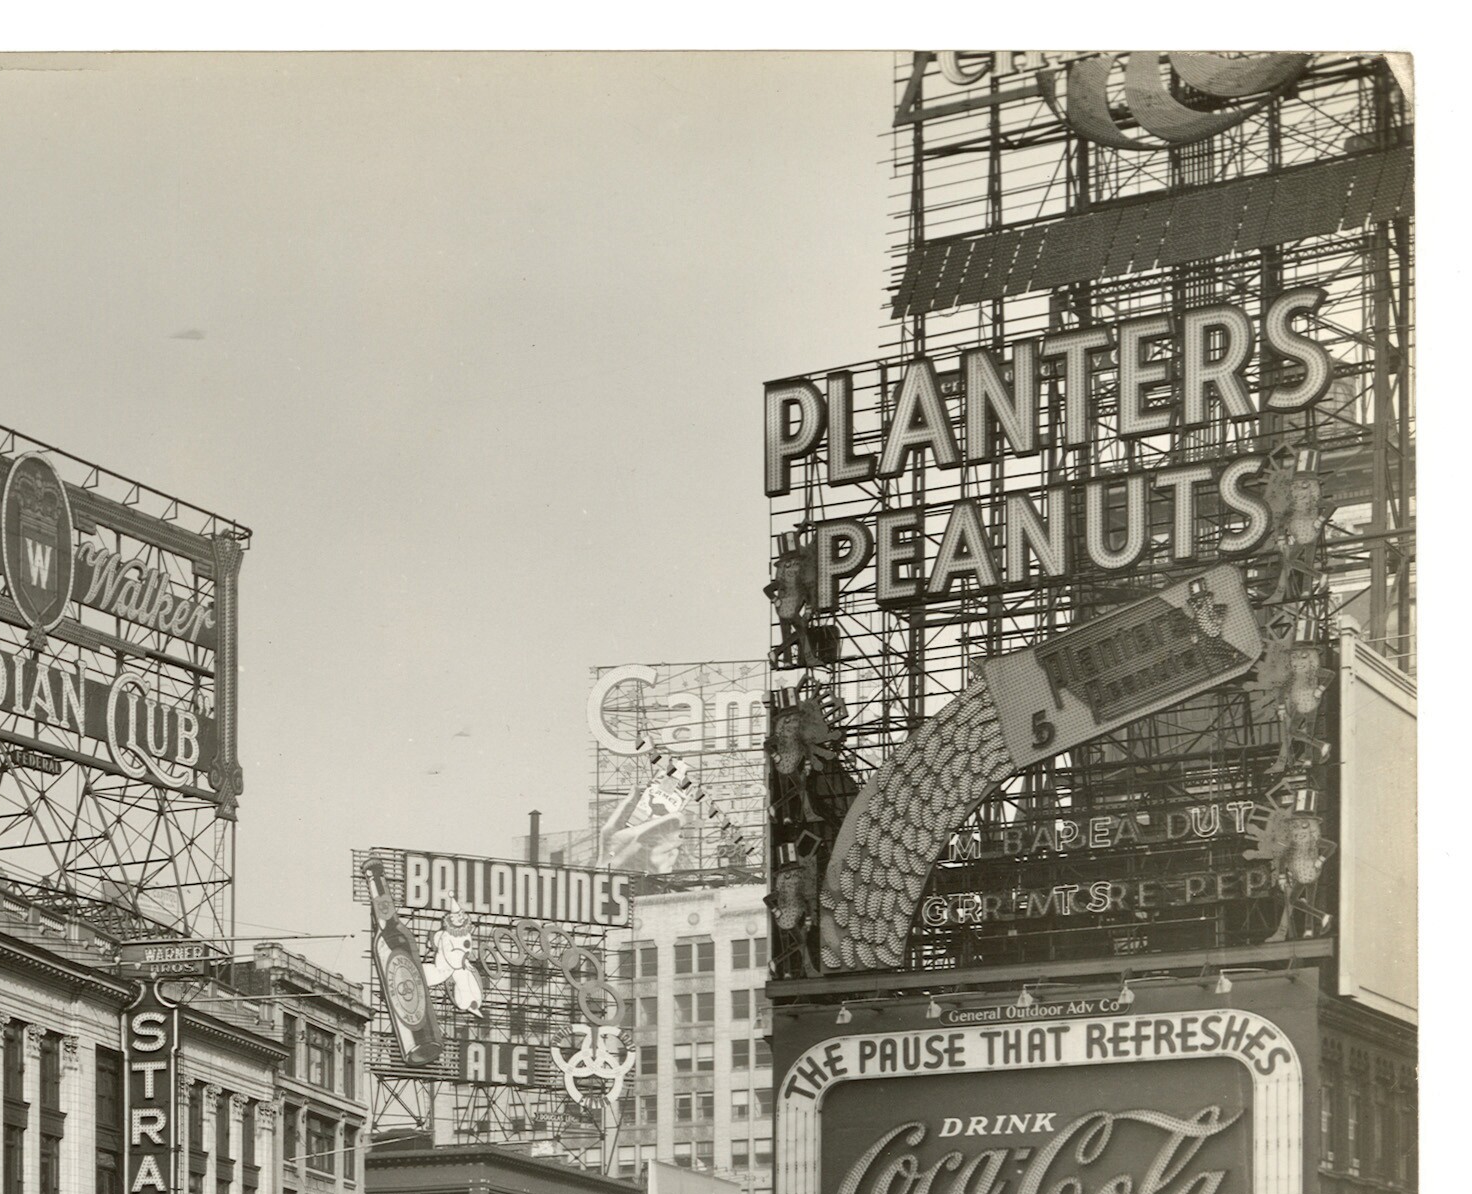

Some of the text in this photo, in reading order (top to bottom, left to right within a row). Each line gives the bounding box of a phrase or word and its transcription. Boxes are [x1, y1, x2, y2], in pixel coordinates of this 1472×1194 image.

[765, 286, 1329, 497] PLANTERS
[26, 536, 51, 590] W
[816, 456, 1272, 609] PEANUTS
[74, 541, 215, 643] Walker
[406, 854, 629, 925] BALLANTINES
[144, 946, 203, 961] WARNER
[949, 999, 1119, 1022] General Outdoor Adv Co
[466, 1043, 529, 1084] ALE
[785, 1015, 1291, 1100] THE PAUSE THAT REFRESHES
[939, 1113, 1057, 1138] DRINK
